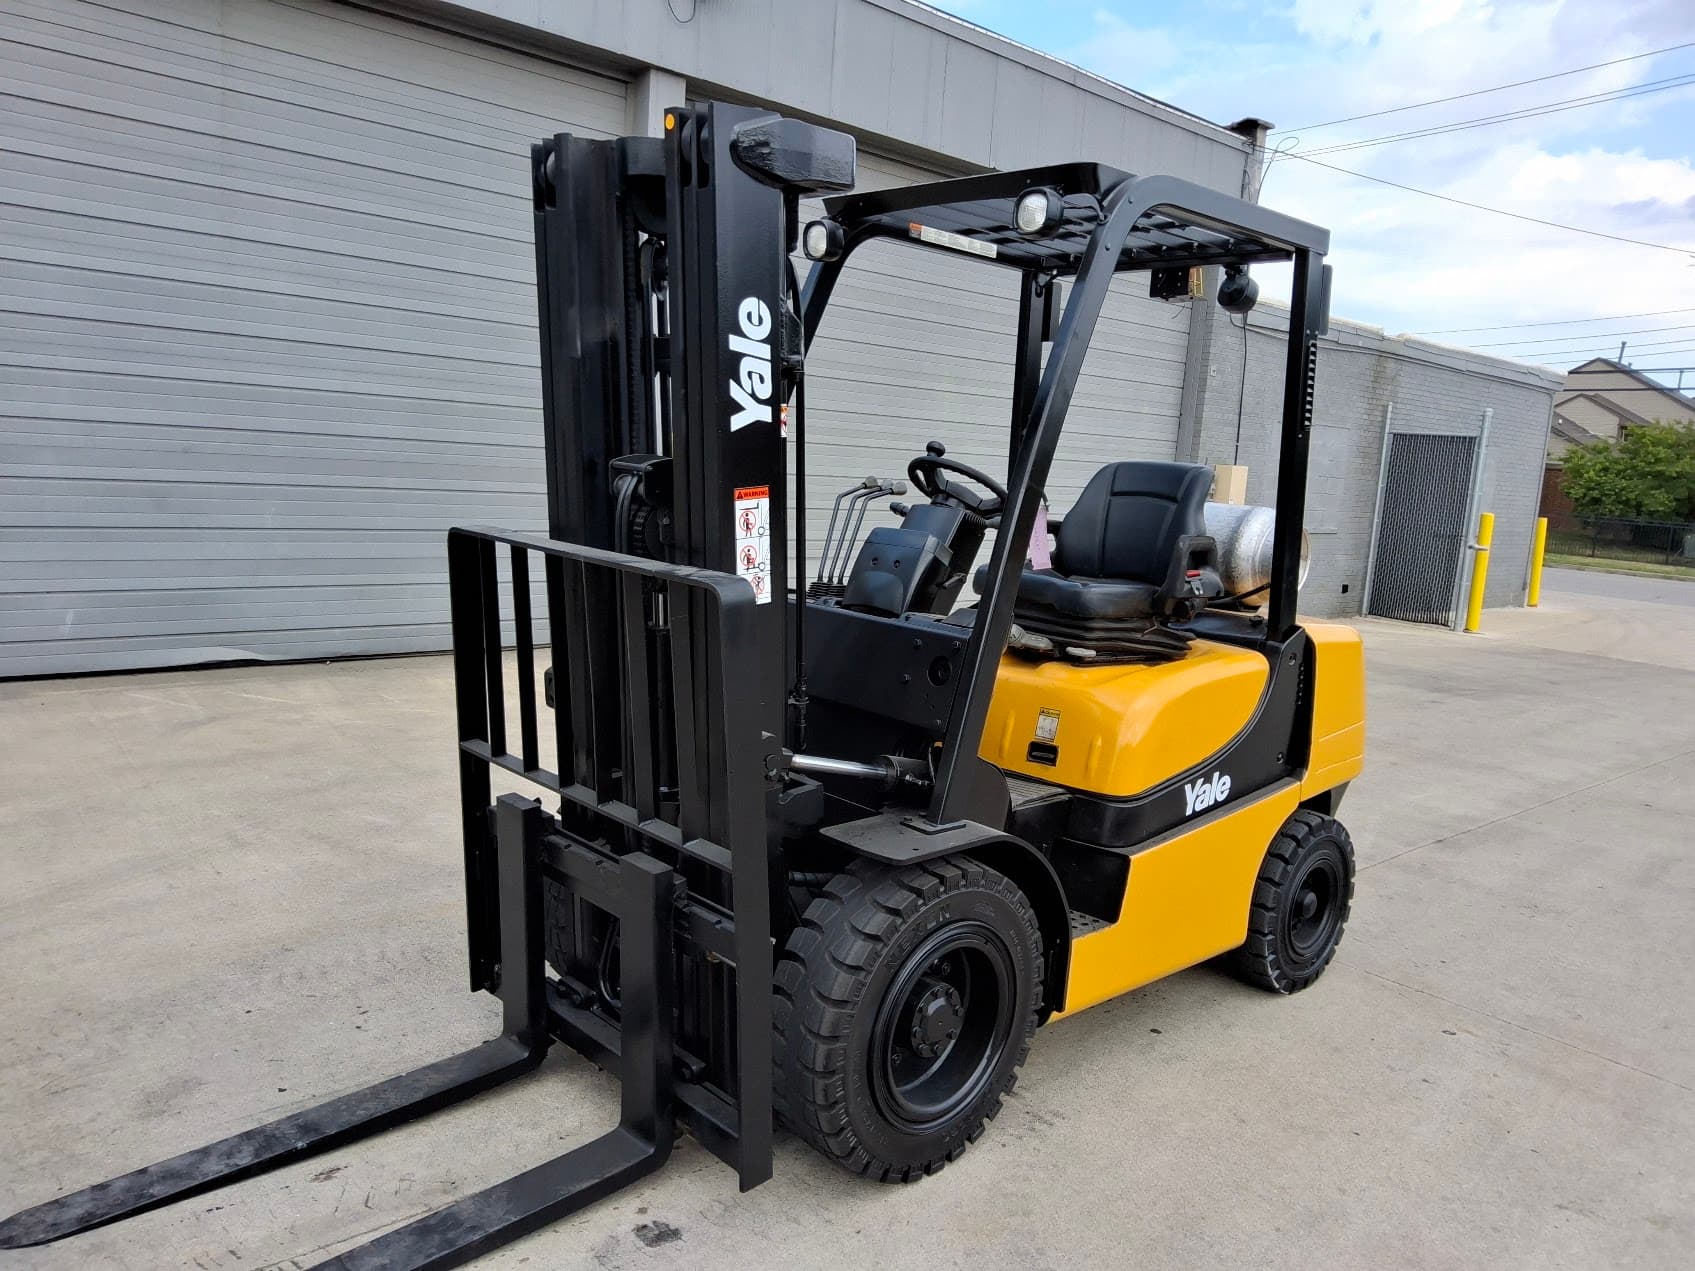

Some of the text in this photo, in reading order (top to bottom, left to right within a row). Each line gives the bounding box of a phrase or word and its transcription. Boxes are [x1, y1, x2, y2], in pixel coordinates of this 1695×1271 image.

[728, 296, 772, 432] Yale
[743, 489, 768, 498] WARNING
[1184, 770, 1232, 817] Yale
